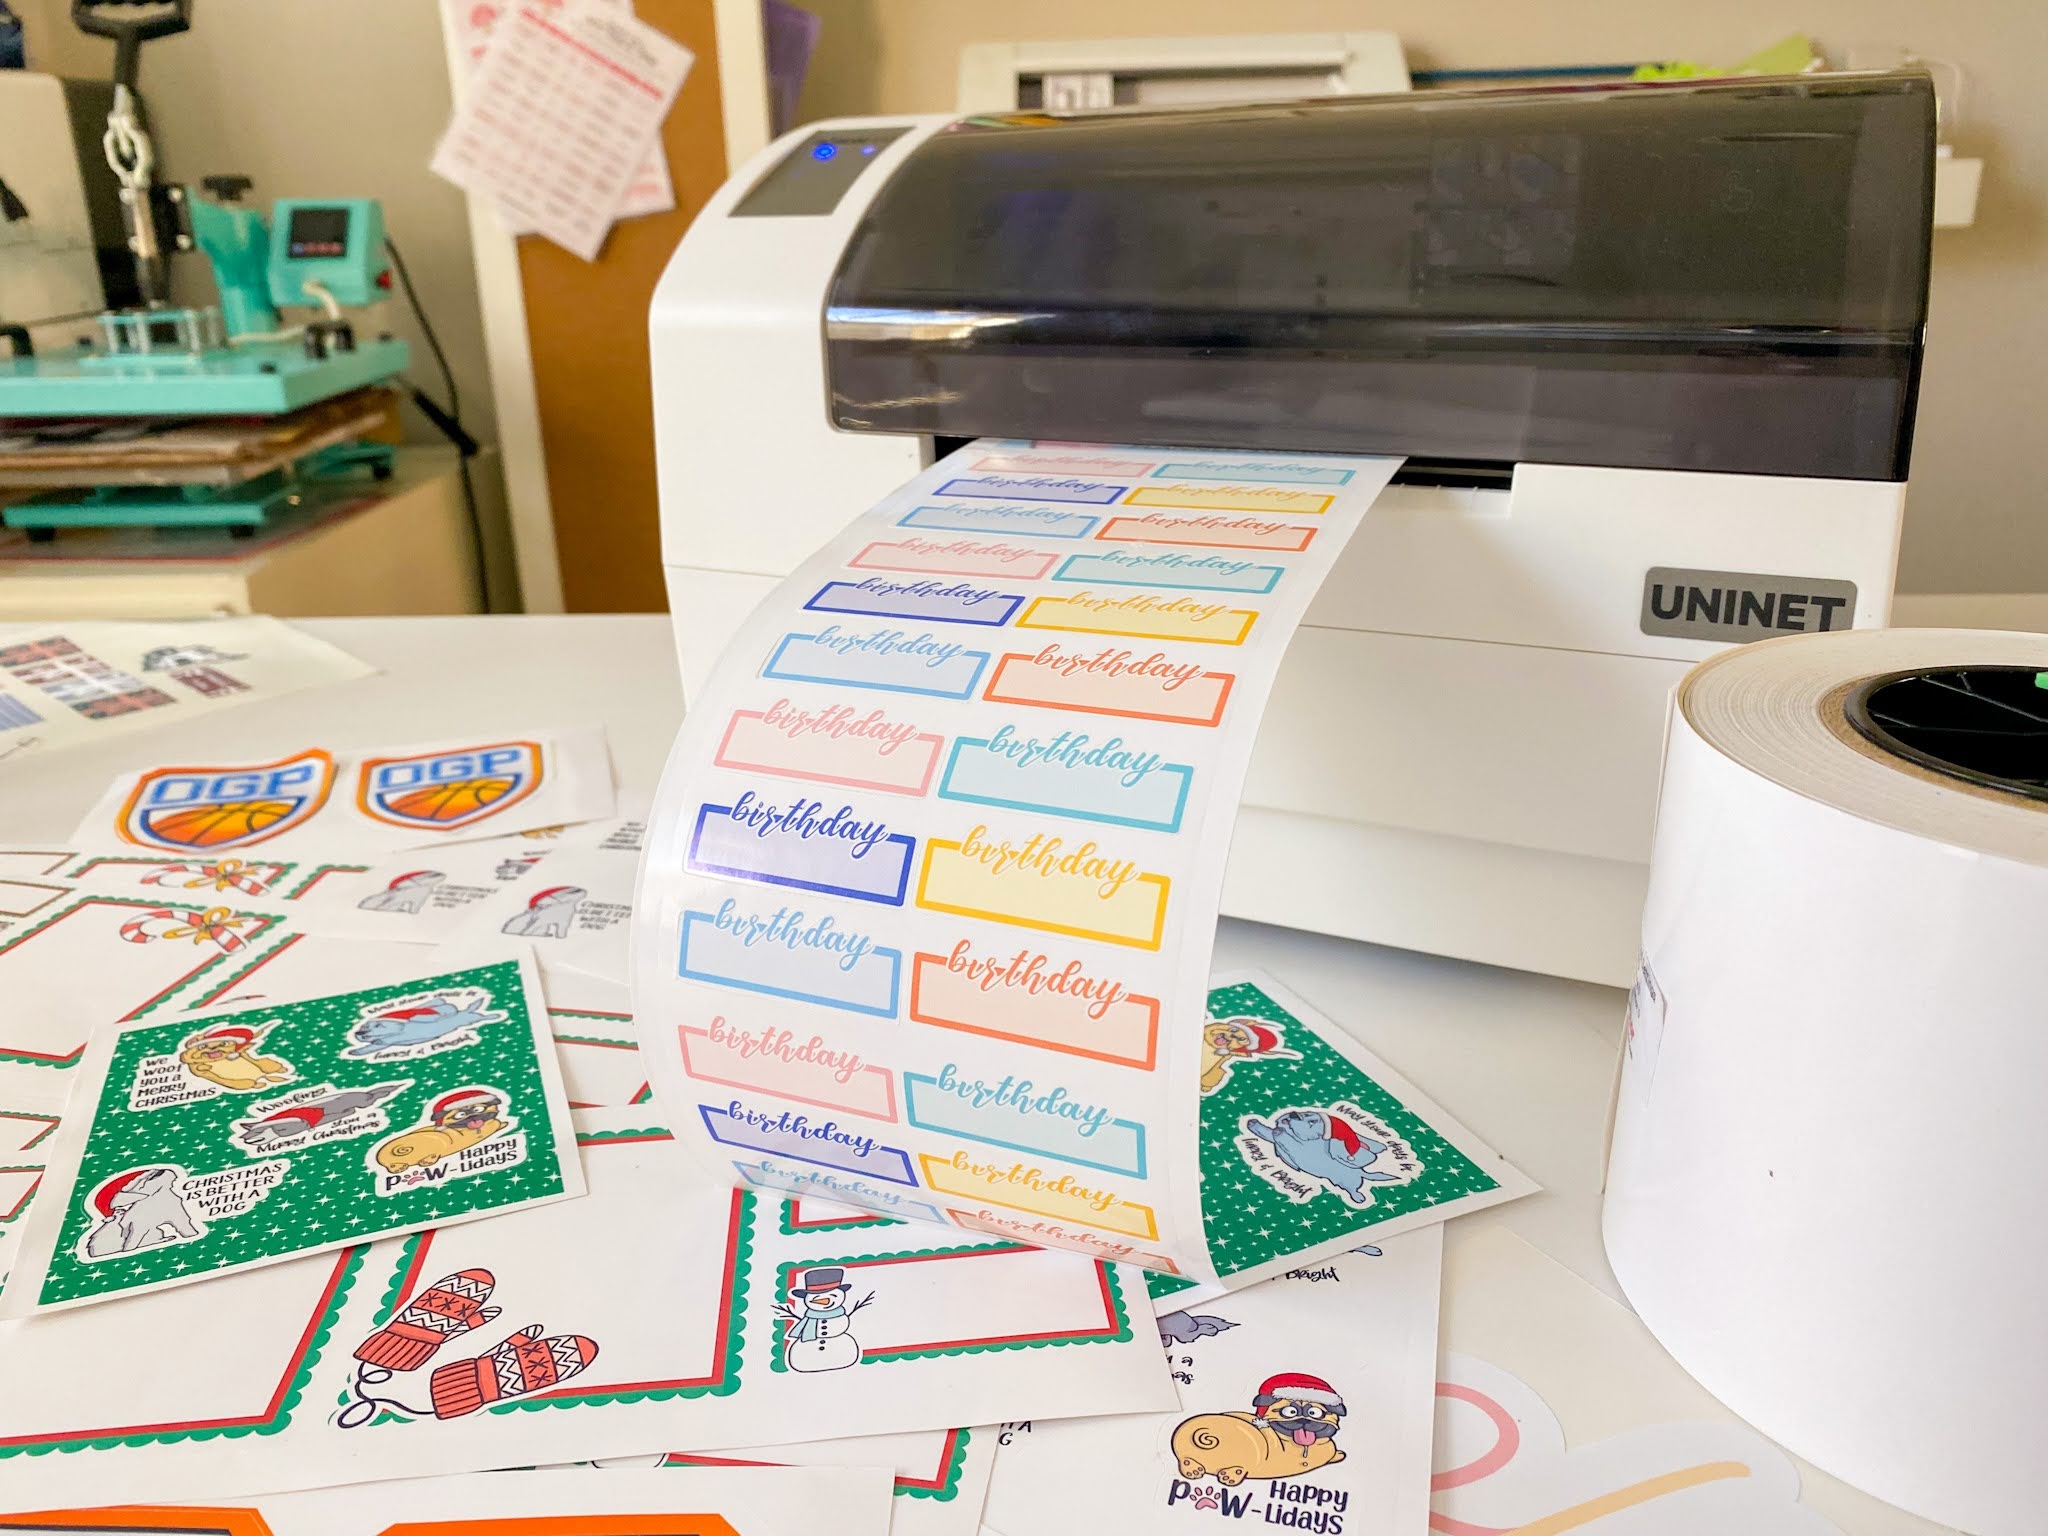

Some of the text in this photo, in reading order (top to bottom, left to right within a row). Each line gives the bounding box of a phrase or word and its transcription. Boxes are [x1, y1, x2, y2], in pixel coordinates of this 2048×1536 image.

[976, 475, 1106, 493] birthday
[1167, 483, 1312, 501] birthday
[945, 502, 1077, 523] birthday
[1139, 512, 1288, 535] birthday
[897, 537, 1031, 563] birthday
[1101, 550, 1259, 576] birthday
[856, 576, 1001, 606] birthday
[1066, 590, 1232, 622] birthday
[1651, 584, 1846, 632] UNINET
[813, 625, 965, 662] birthday
[1033, 643, 1203, 684] birthday
[761, 699, 918, 756] birthday
[988, 724, 1162, 787] birthday
[730, 790, 889, 859] birthday
[961, 824, 1140, 900] birthday
[713, 897, 873, 972] birthday
[947, 938, 1127, 1019] birthday
[707, 1015, 865, 1083] birthday
[937, 1062, 1114, 1137] birthday
[726, 1099, 881, 1158] birthday
[460, 1138, 517, 1161] Happy
[181, 1163, 283, 1191] CHRISTMAS
[186, 1175, 275, 1201] IS BETTER
[758, 1158, 905, 1206] birthday
[951, 1150, 1123, 1212] birthday
[198, 1189, 261, 1209] WITH A
[208, 1201, 247, 1217] DOG
[975, 1209, 1138, 1256] birthday
[1269, 1480, 1349, 1513] Happy
